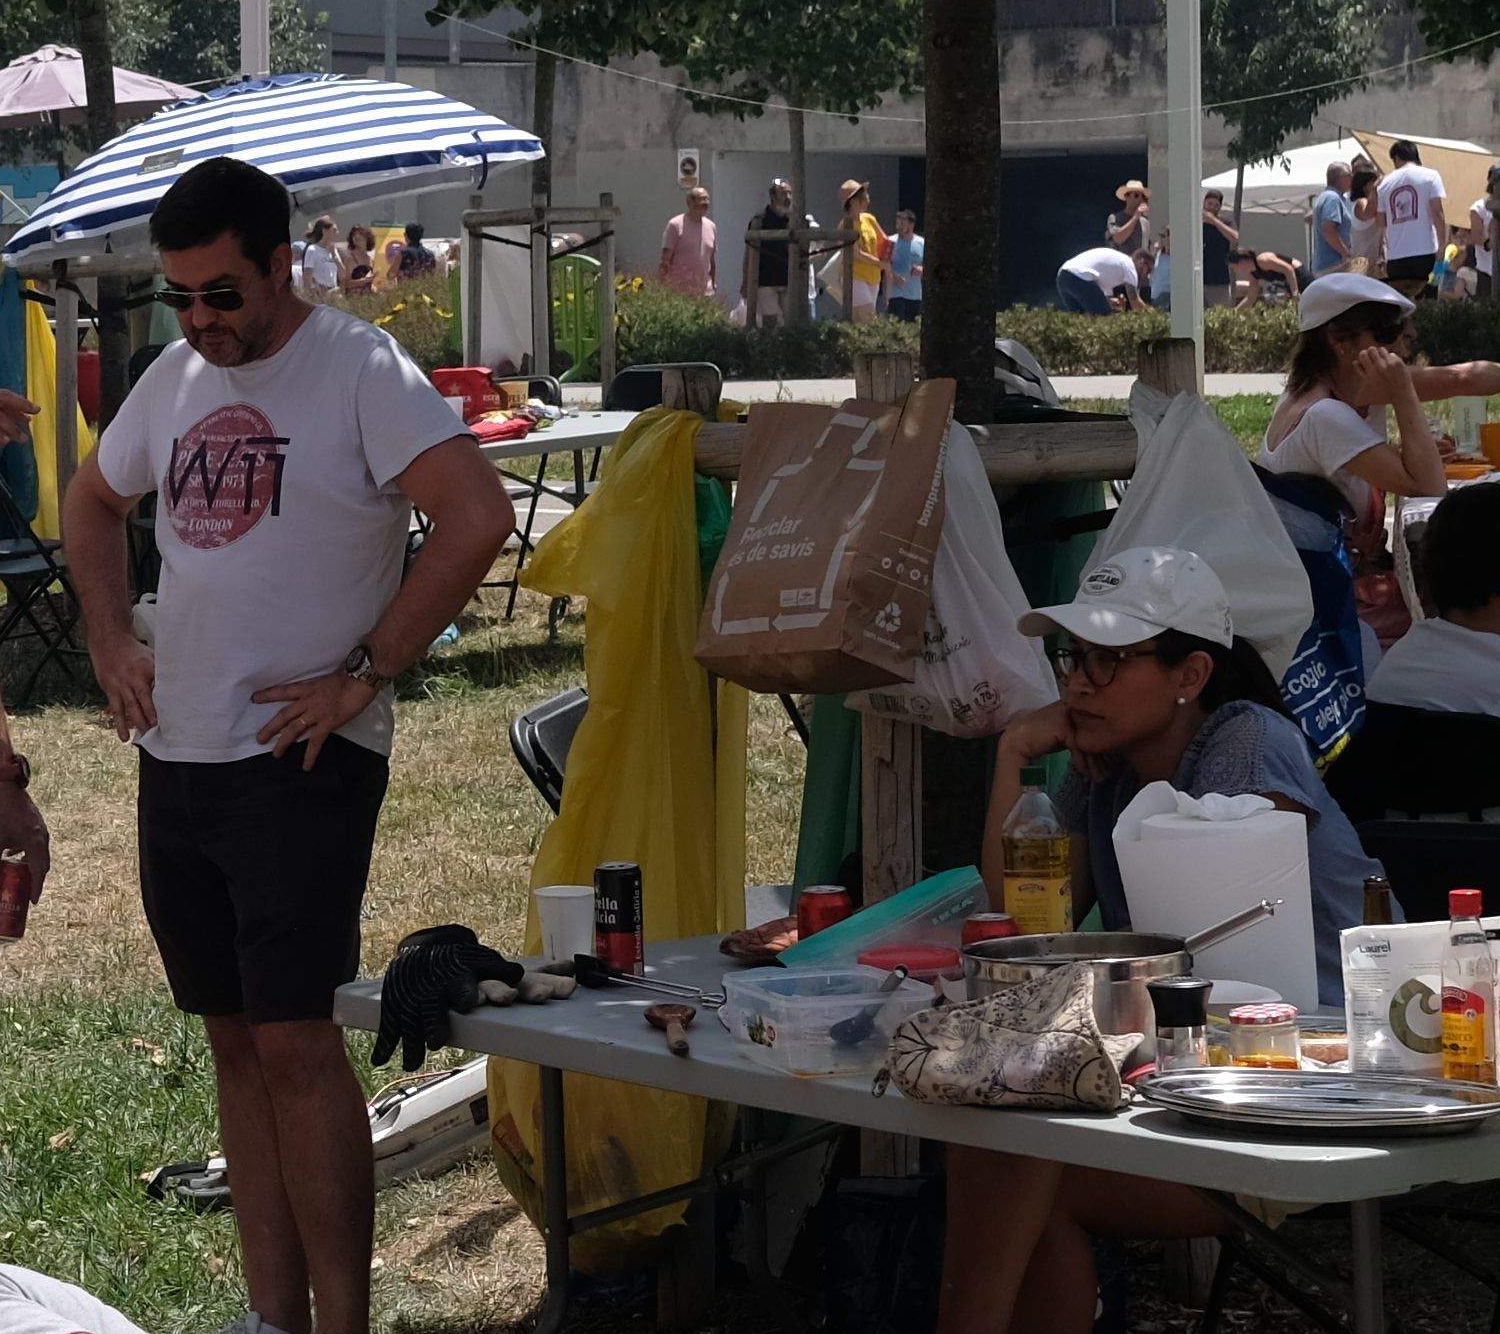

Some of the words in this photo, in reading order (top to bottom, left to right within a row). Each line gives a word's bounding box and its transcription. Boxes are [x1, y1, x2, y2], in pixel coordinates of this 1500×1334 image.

[188, 518, 234, 532] LONDON
[747, 542, 767, 562] de
[769, 537, 816, 559] savis
[1359, 939, 1391, 954] Laurel
